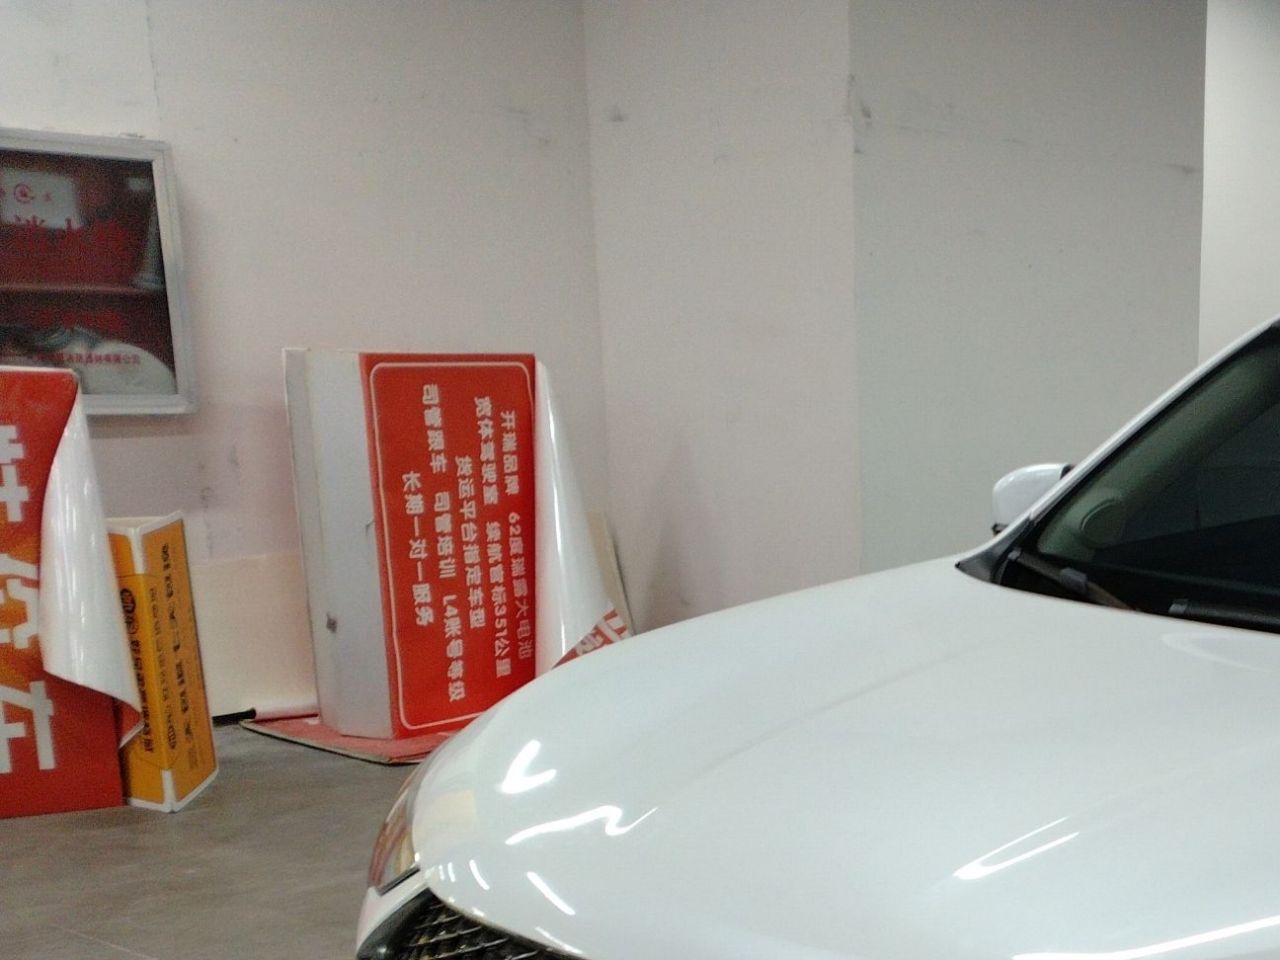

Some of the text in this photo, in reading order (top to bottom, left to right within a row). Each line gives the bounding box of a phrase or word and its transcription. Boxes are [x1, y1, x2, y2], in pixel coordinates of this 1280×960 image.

[475, 396, 498, 505] 宽体驾驶室
[501, 411, 520, 495] 开瑞品牌
[402, 471, 434, 626] 长期一对一服务
[455, 456, 485, 628] 货运平台指定车型
